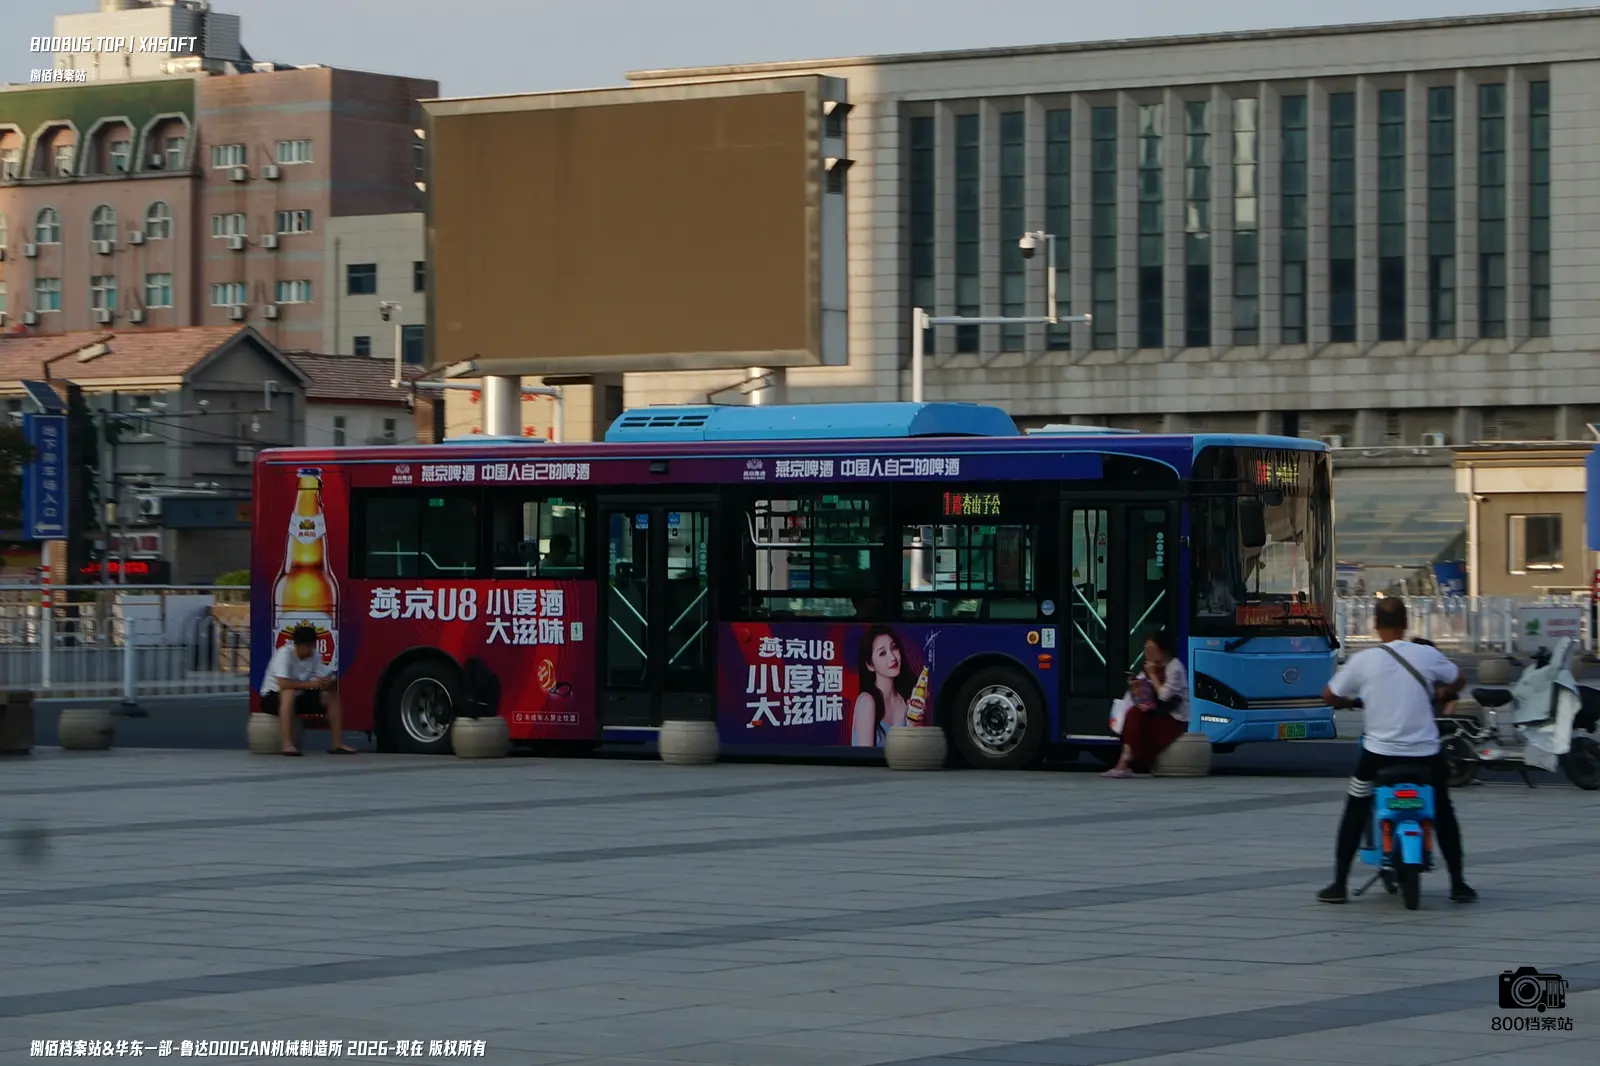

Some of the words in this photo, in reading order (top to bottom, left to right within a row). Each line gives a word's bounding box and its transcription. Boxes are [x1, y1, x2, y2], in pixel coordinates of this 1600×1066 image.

[421, 465, 475, 482] 燕京啤酒
[481, 463, 590, 481] 中国人自己的啤酒
[775, 460, 834, 478] 燕京啤酒
[840, 458, 960, 477] 中国人自己的啤酒
[369, 587, 477, 621] 燕京U8
[486, 588, 565, 617] 小度酒
[486, 618, 565, 645] 大滋味
[758, 636, 835, 660] 燕京U8
[746, 663, 844, 694] 小度酒
[746, 695, 843, 729] 大滋味
